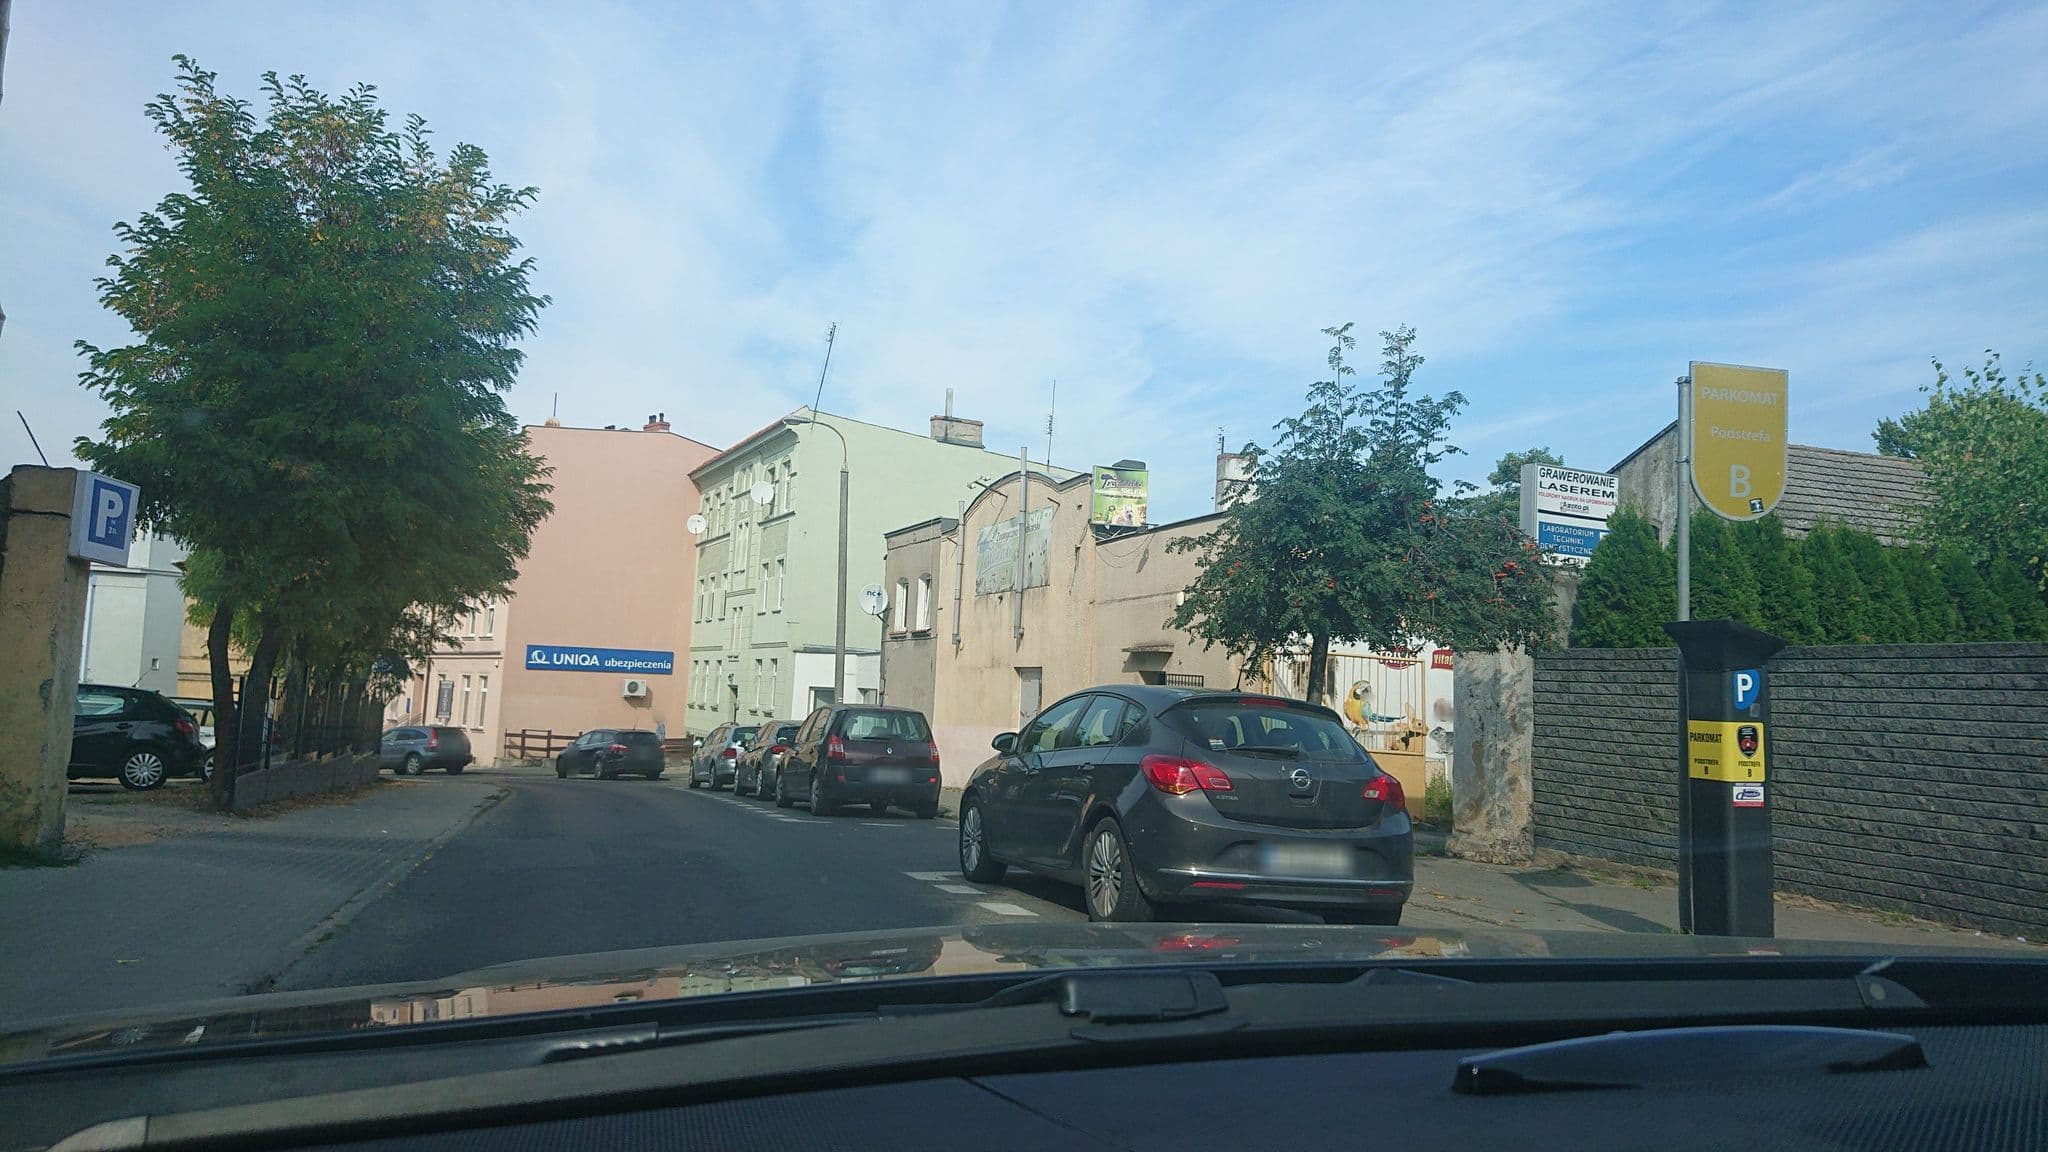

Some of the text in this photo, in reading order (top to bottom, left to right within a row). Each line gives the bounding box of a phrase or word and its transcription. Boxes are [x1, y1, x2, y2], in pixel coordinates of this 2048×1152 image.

[1702, 387, 1778, 405] PARKOMAT
[1711, 425, 1771, 442] Podstrefa
[1539, 467, 1615, 488] GRAWEROWANIE
[1730, 464, 1753, 498] B
[1539, 481, 1615, 499] LASEREM
[95, 487, 124, 538] P
[1542, 524, 1595, 537] LABORATORIUM
[1540, 542, 1593, 556] DENTYSTYCZNE
[1552, 535, 1584, 545] TECHNIKI
[553, 653, 672, 671] UNIQA ubezpieczenia
[1737, 673, 1753, 702] P
[1689, 732, 1722, 744] PARKOMAT
